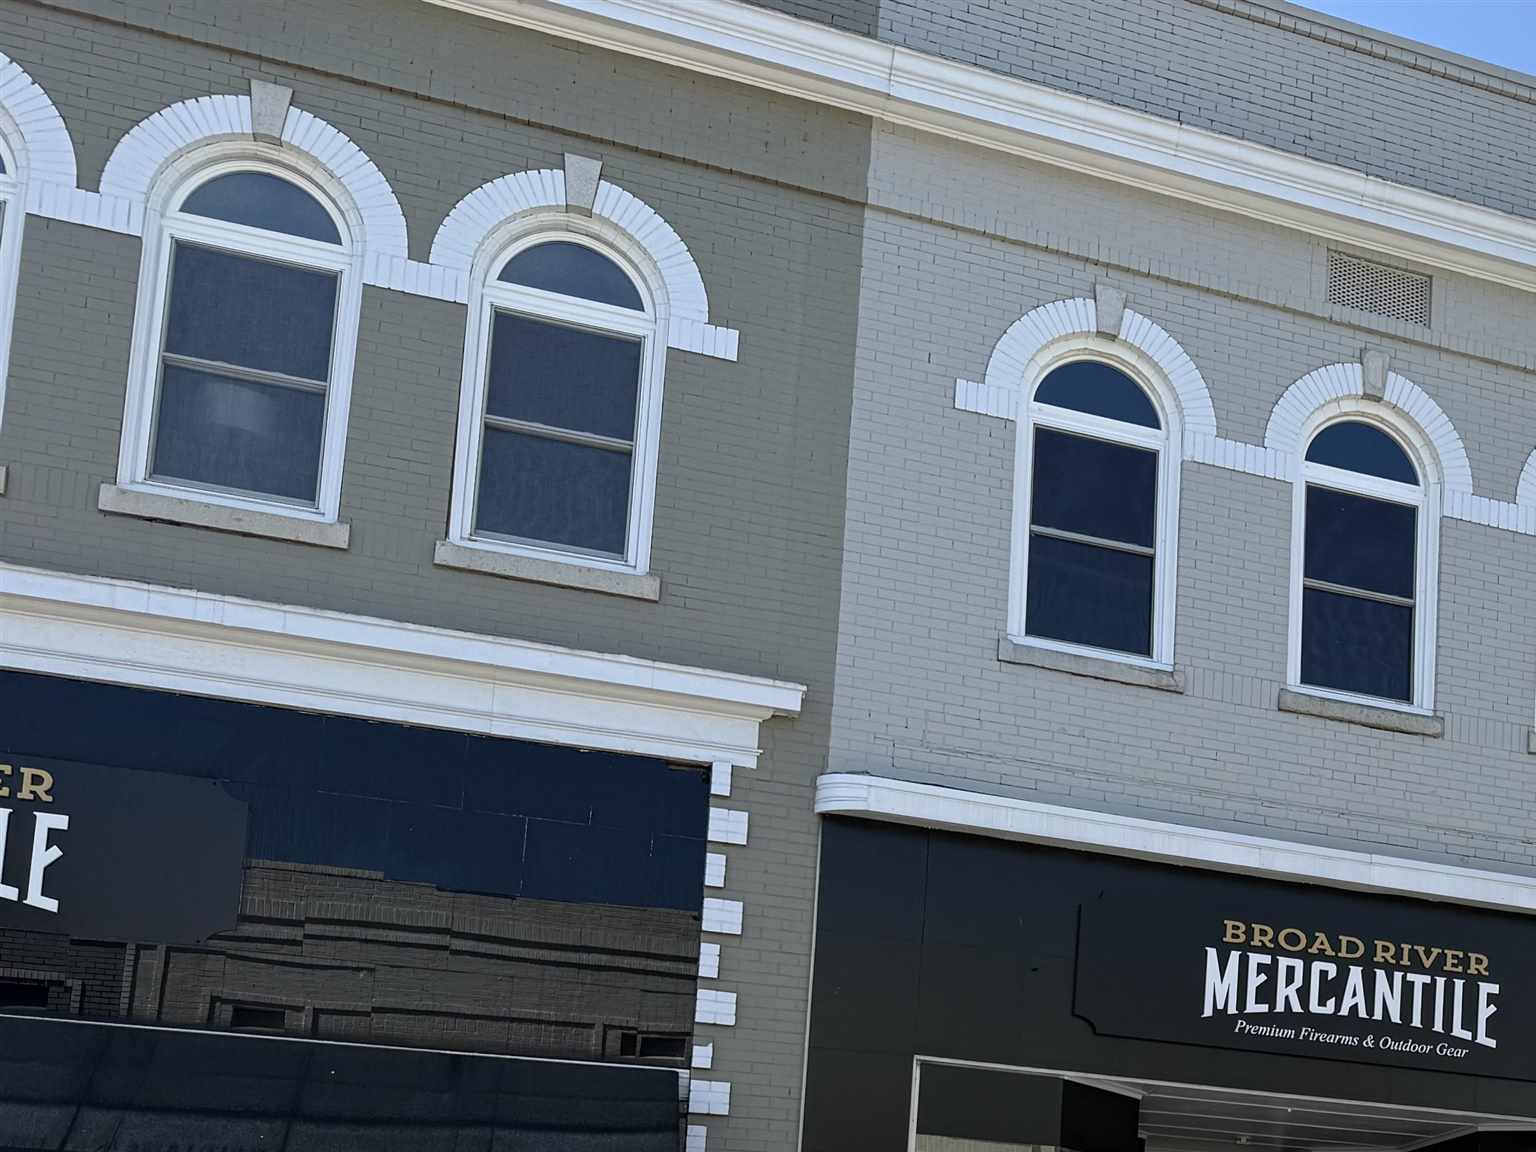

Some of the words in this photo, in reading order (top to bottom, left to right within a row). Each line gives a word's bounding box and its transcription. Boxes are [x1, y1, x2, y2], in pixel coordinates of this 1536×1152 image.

[1222, 919, 1365, 959] BROAD
[1374, 940, 1490, 976] RIVER
[1201, 947, 1500, 1049] MERCANTILE
[1234, 1019, 1296, 1040] Premium
[1299, 1027, 1360, 1048] Firearms
[1363, 1034, 1375, 1048] &
[1379, 1036, 1434, 1056] Outdoor
[1436, 1042, 1469, 1058] Gear
